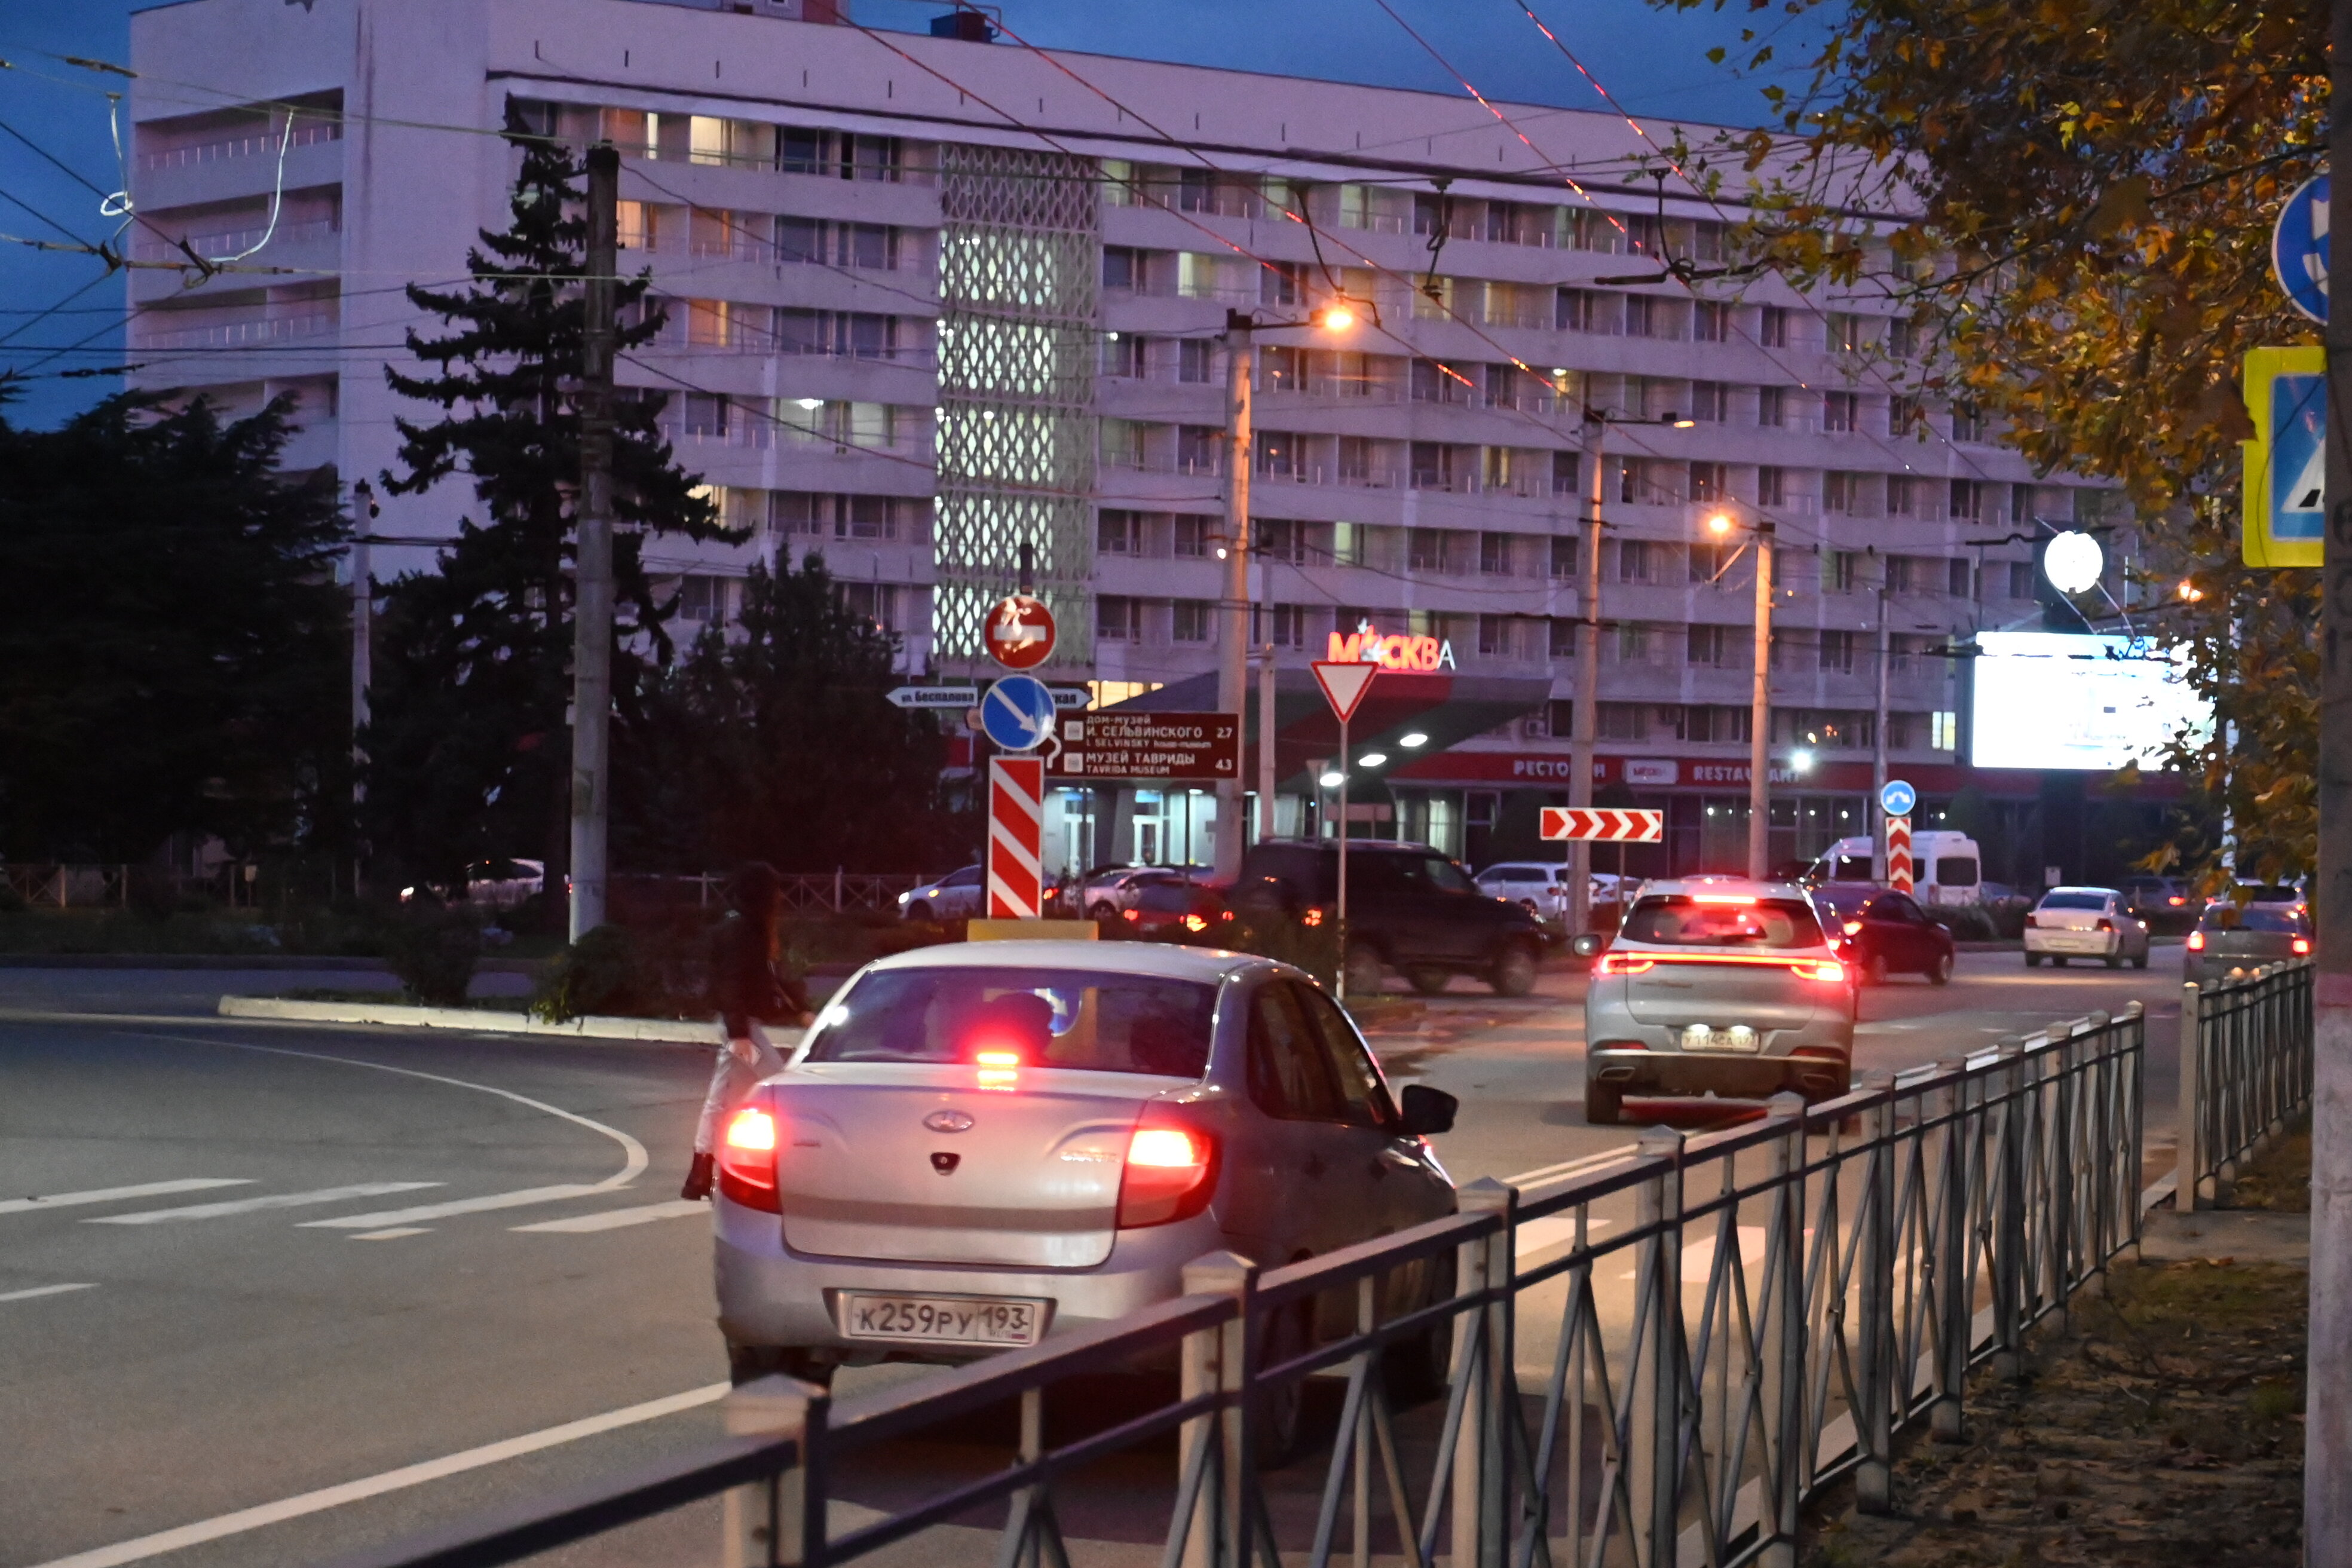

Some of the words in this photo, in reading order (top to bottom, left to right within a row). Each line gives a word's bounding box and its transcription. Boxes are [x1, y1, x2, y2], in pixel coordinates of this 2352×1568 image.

[915, 690, 975, 702] Беспалова
[1102, 726, 1203, 738] СЕЛЬВИНСКОГО
[1095, 738, 1149, 747] SELVINSKY
[1086, 751, 1129, 763] МУЗЕЙ
[1135, 753, 1195, 765] ТАВРИДЫ
[1086, 765, 1128, 774] TAVRIDA
[1130, 766, 1170, 774] MUSEUM
[859, 1302, 973, 1336] К259РУ
[979, 1306, 1026, 1330] 193
